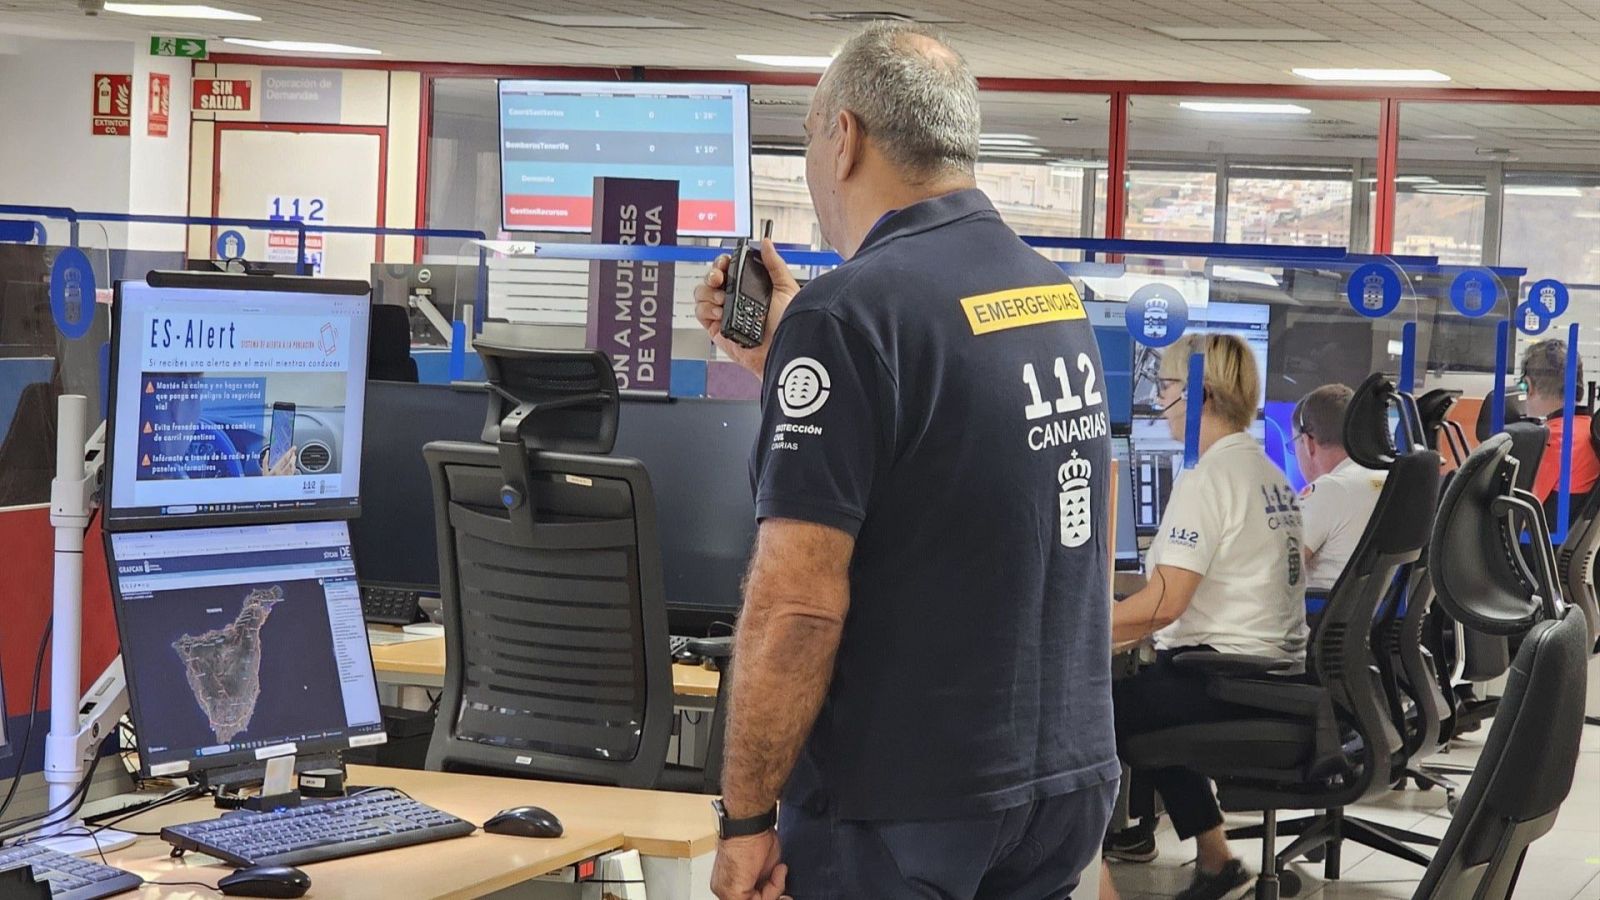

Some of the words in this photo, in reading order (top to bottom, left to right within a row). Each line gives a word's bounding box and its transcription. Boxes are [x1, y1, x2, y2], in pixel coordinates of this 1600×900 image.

[211, 80, 234, 95] SIN
[319, 78, 332, 88] de
[266, 90, 319, 100] Demandas
[200, 95, 243, 110] SALIDA
[94, 119, 129, 127] EXTINTOR
[270, 196, 324, 221] 112
[973, 292, 1079, 324] EMERGENCIAS
[151, 318, 235, 349] ES-Alert
[614, 328, 631, 348] A
[148, 358, 156, 367] Si
[159, 357, 188, 367] recibes
[206, 358, 230, 367] alerta
[244, 357, 251, 367] el
[275, 359, 306, 367] mientras
[308, 358, 340, 367] conduces
[637, 348, 655, 381] DE
[1023, 352, 1103, 420] 112
[155, 393, 168, 401] que
[169, 393, 189, 401] ponga
[231, 392, 261, 401] seguridad
[154, 423, 171, 431] Evita
[172, 422, 199, 431] frenadas
[231, 422, 256, 430] cambios
[1027, 411, 1107, 451] CANARIAS
[153, 433, 162, 441] de
[163, 433, 181, 441] carril
[220, 452, 228, 460] la
[228, 452, 245, 460] radio
[251, 451, 261, 460] los
[152, 465, 177, 474] paneles
